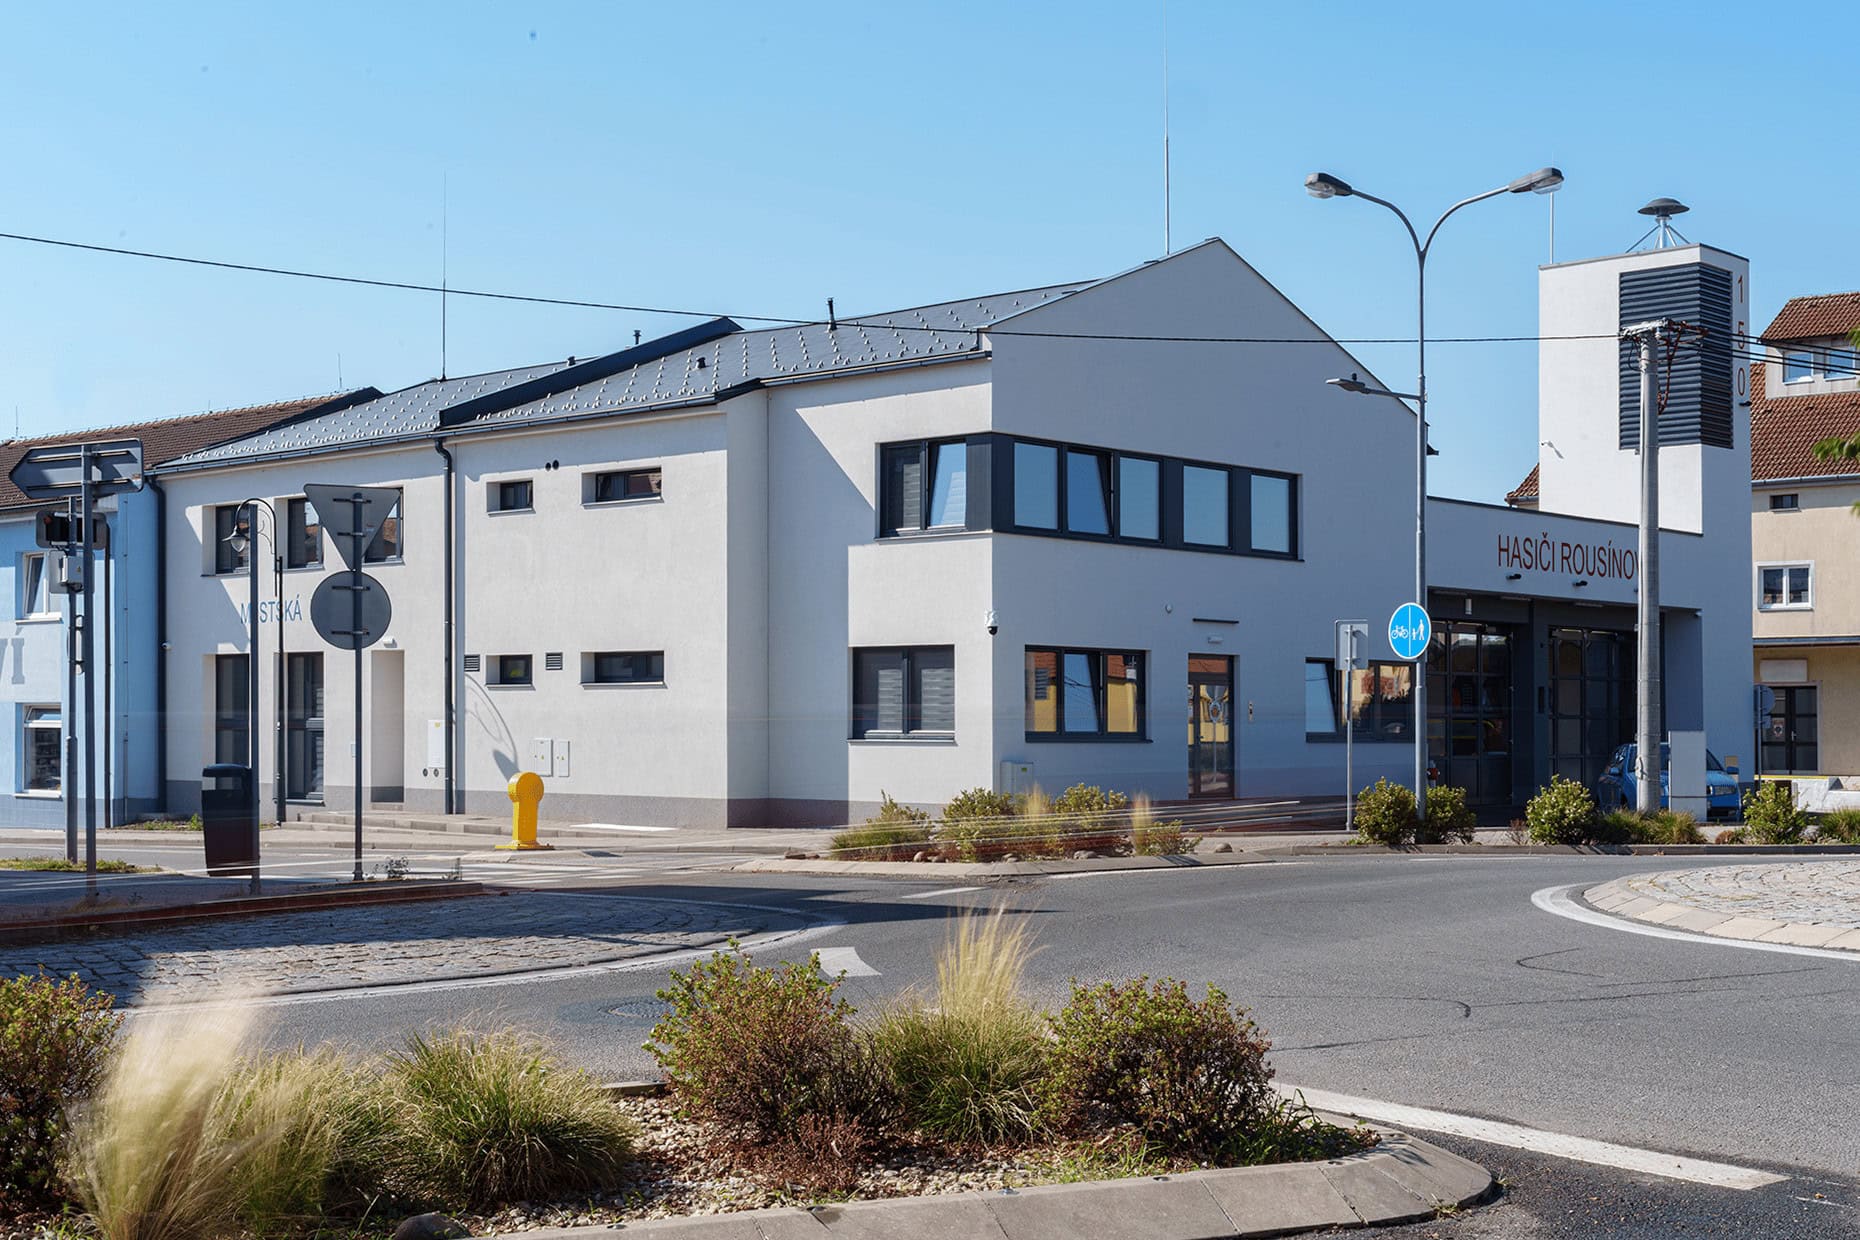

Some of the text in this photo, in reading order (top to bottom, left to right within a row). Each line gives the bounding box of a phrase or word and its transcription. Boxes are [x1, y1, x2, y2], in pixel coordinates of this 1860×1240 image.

[1737, 275, 1746, 396] 150
[1498, 532, 1555, 573] HASIČI
[240, 593, 302, 625] MSTSKÁ
